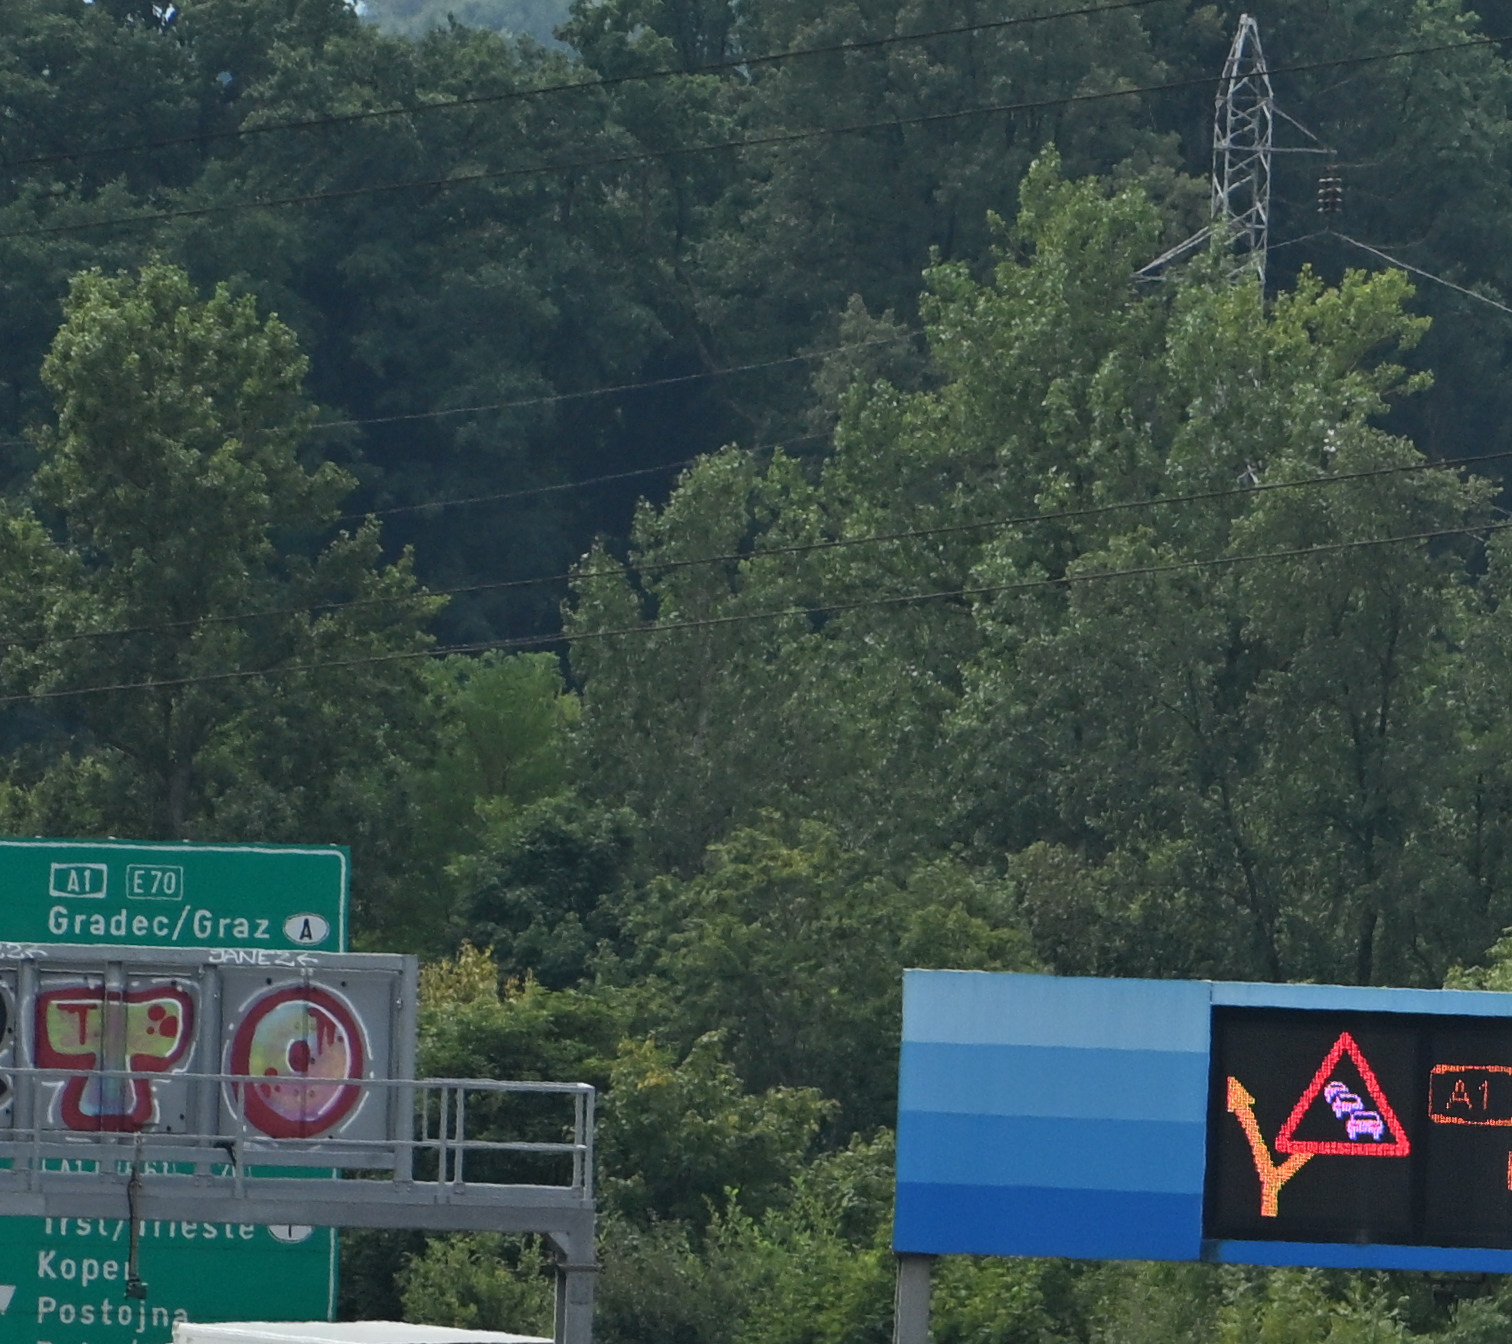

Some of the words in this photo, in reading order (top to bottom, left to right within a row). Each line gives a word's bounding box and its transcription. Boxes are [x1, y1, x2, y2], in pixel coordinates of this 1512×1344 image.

[67, 870, 91, 892] A1
[133, 871, 142, 893] E
[151, 871, 177, 894] 70
[48, 905, 271, 940] Gradec/Graz
[299, 918, 312, 941] A
[1446, 1080, 1492, 1110] A1
[38, 1296, 189, 1333] Postojna
